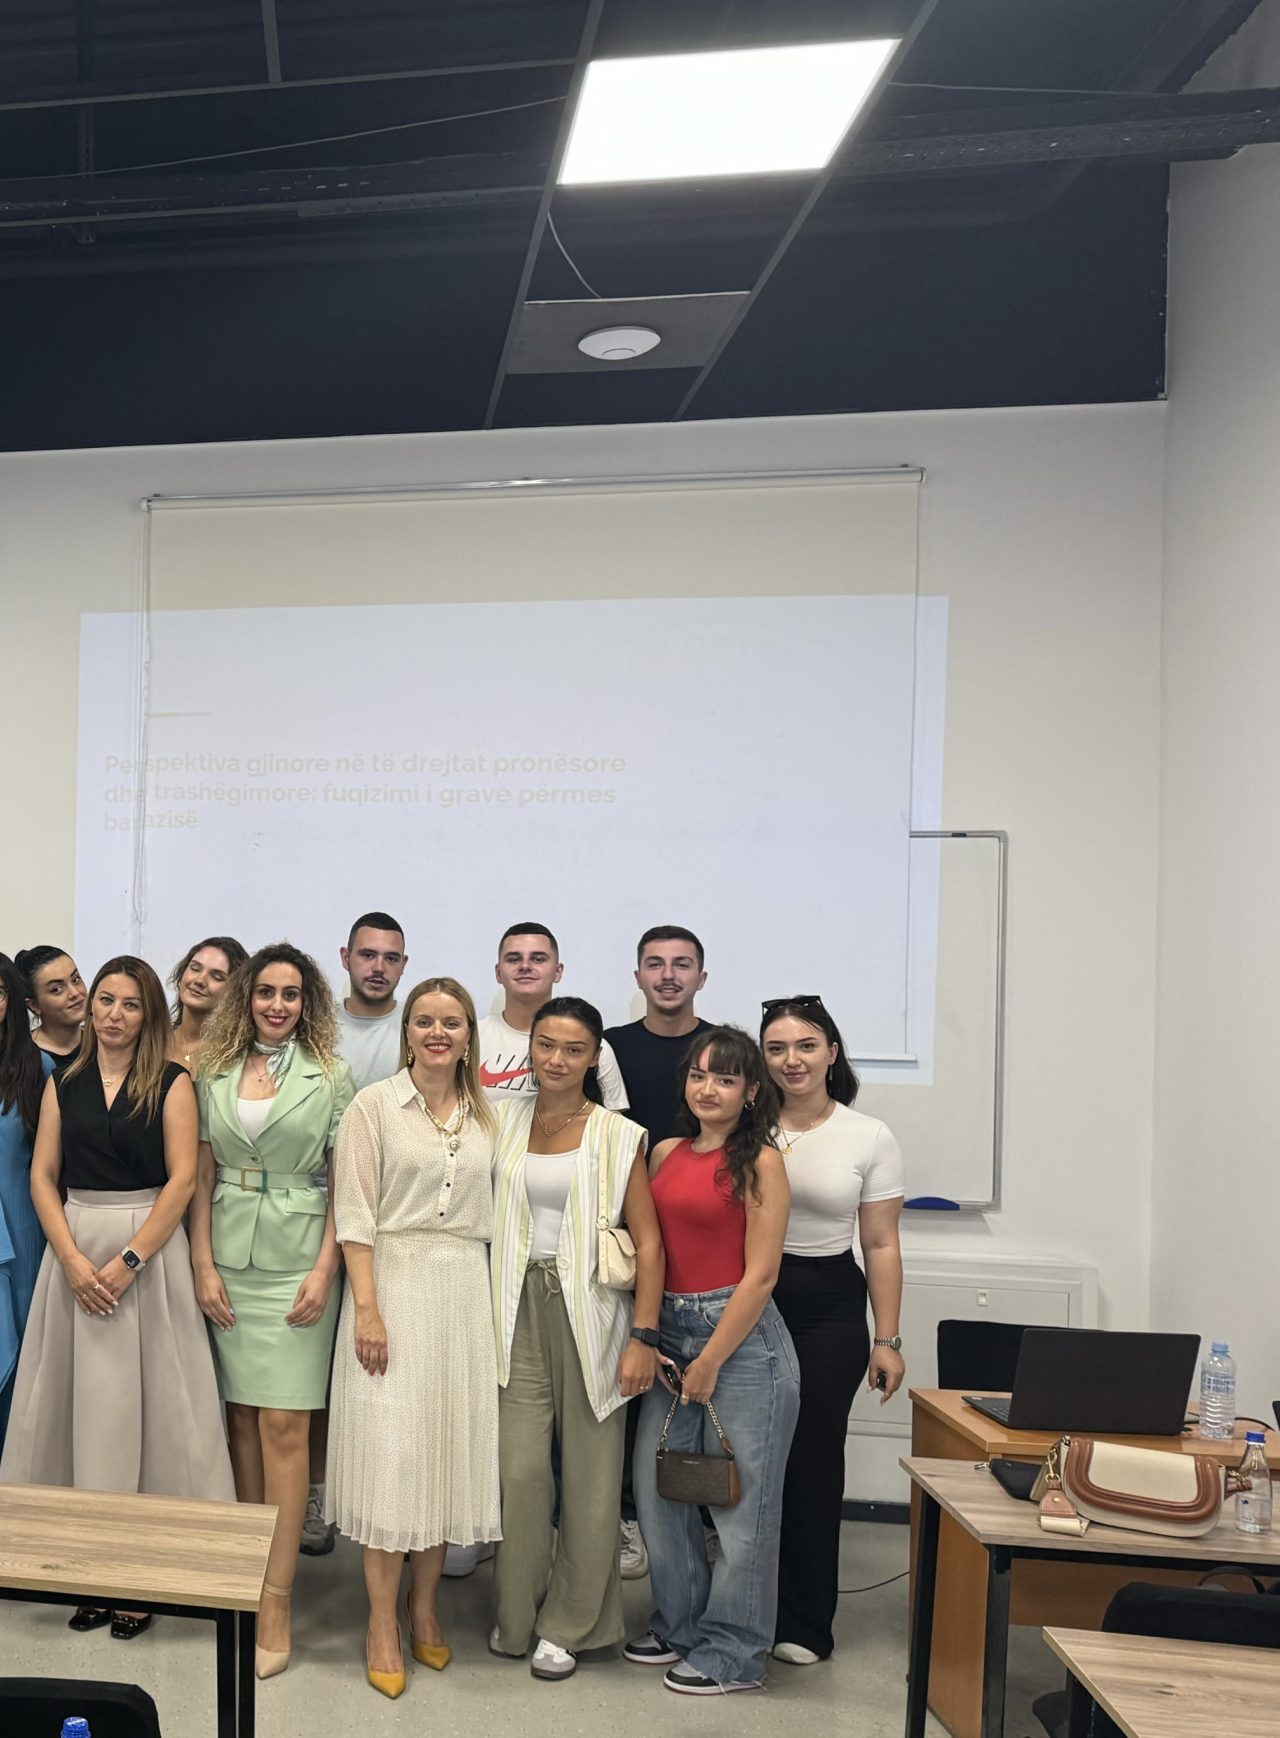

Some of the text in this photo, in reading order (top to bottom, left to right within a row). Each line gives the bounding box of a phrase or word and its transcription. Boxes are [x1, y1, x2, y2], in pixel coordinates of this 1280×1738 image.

[104, 752, 627, 778] Pespektiva gjinore në të drejtat pronësore
[323, 782, 420, 807] fuqizimi
[427, 784, 432, 803] i
[439, 787, 512, 808] grave
[518, 783, 617, 808] përmes
